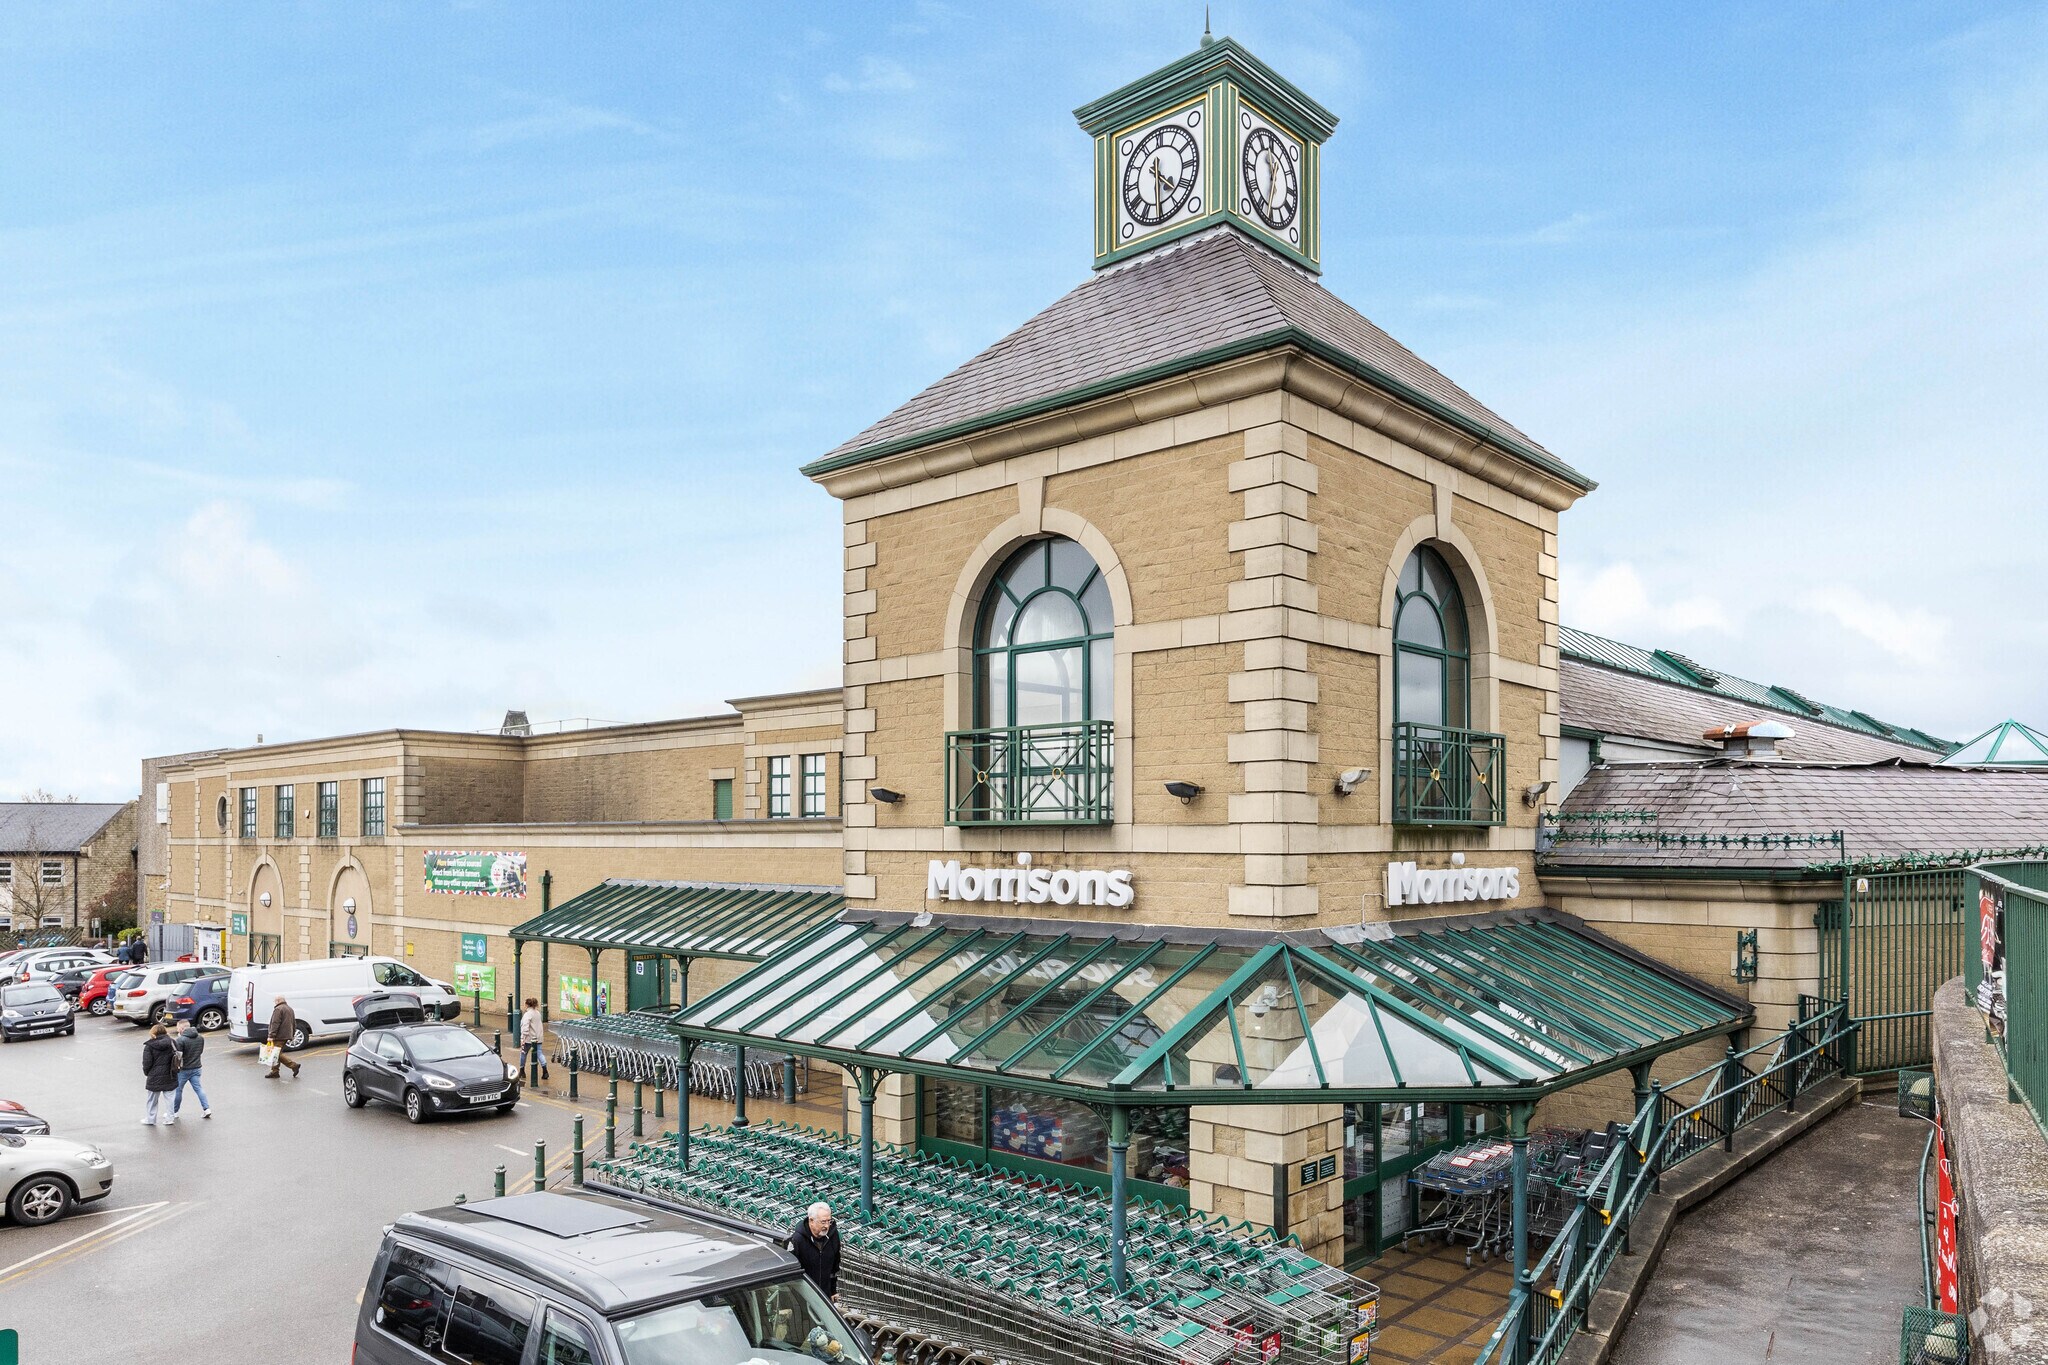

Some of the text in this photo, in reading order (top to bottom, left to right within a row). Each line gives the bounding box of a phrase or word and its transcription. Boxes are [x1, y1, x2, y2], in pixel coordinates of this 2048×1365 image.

[447, 858, 456, 866] fresh
[467, 859, 482, 868] sourced
[432, 868, 443, 876] direct
[443, 868, 452, 876] from
[465, 869, 480, 877] farmers
[435, 877, 443, 885] than
[451, 878, 461, 886] other
[461, 879, 486, 889] supermarket
[927, 852, 1134, 906] Morrisons
[1388, 852, 1520, 906] Morrisons
